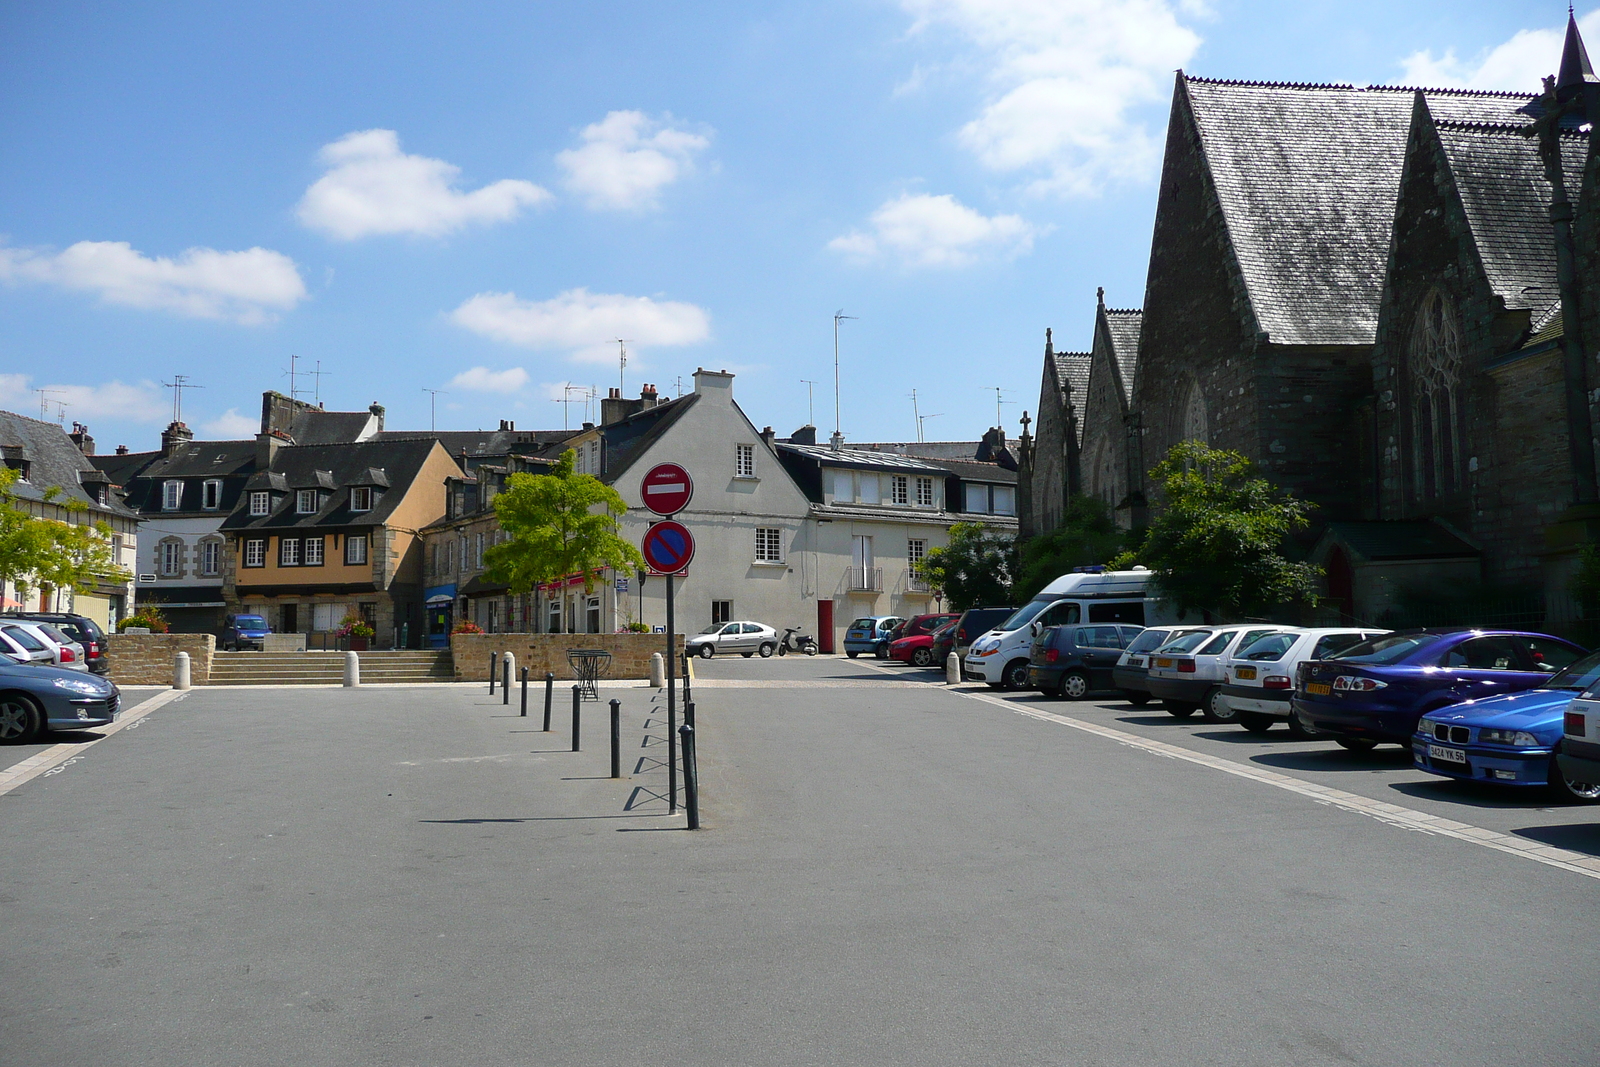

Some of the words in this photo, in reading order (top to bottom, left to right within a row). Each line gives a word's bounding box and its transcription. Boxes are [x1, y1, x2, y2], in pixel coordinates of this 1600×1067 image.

[1430, 746, 1445, 758] 9424
[1445, 749, 1454, 760] YK
[1455, 750, 1465, 762] 56
